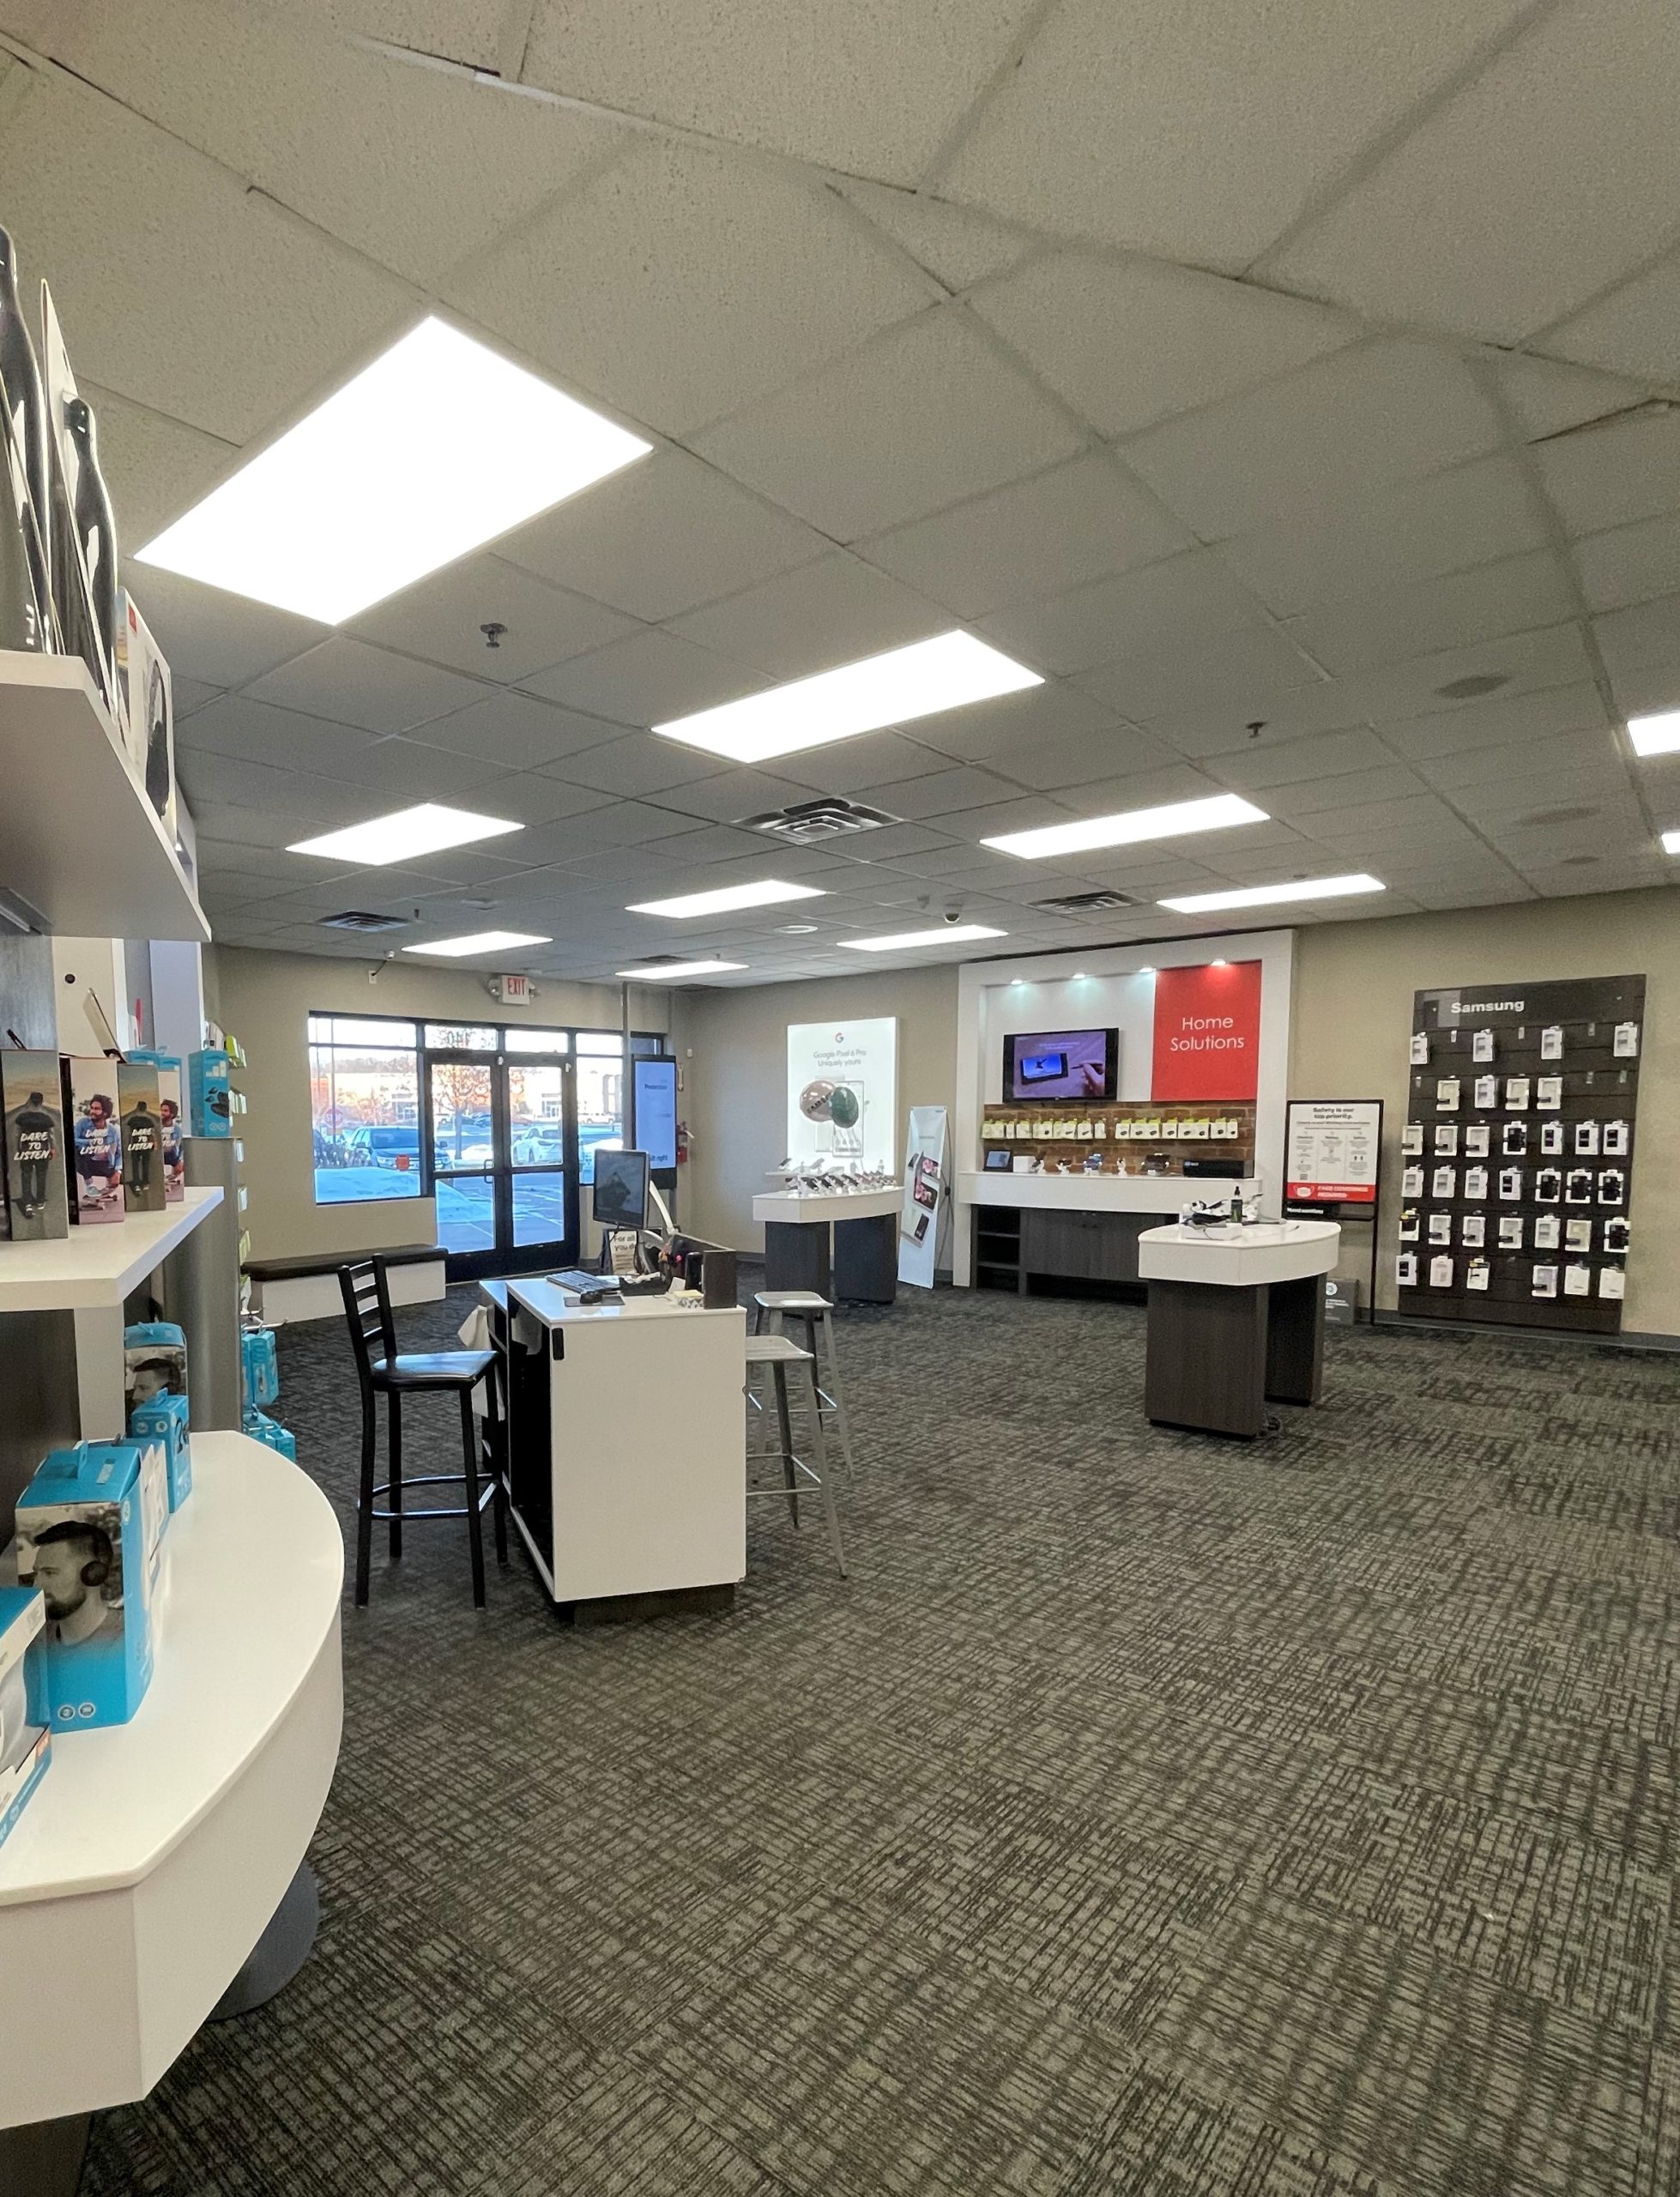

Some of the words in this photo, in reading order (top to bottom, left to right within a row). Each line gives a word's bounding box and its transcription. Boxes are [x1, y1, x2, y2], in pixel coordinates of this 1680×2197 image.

[507, 977, 525, 996] EXIT
[1450, 1000, 1525, 1014] Samsung
[1182, 1017, 1234, 1031] Home
[1169, 1035, 1245, 1051] Solutions
[813, 1051, 836, 1060] Google
[21, 1131, 49, 1142] DARE
[86, 1129, 109, 1138] DARE
[132, 1128, 153, 1137] DARE
[28, 1141, 41, 1150] TO
[80, 1144, 111, 1155] LISTEN
[127, 1141, 154, 1152] LISTEN
[14, 1150, 50, 1160] LISTEN
